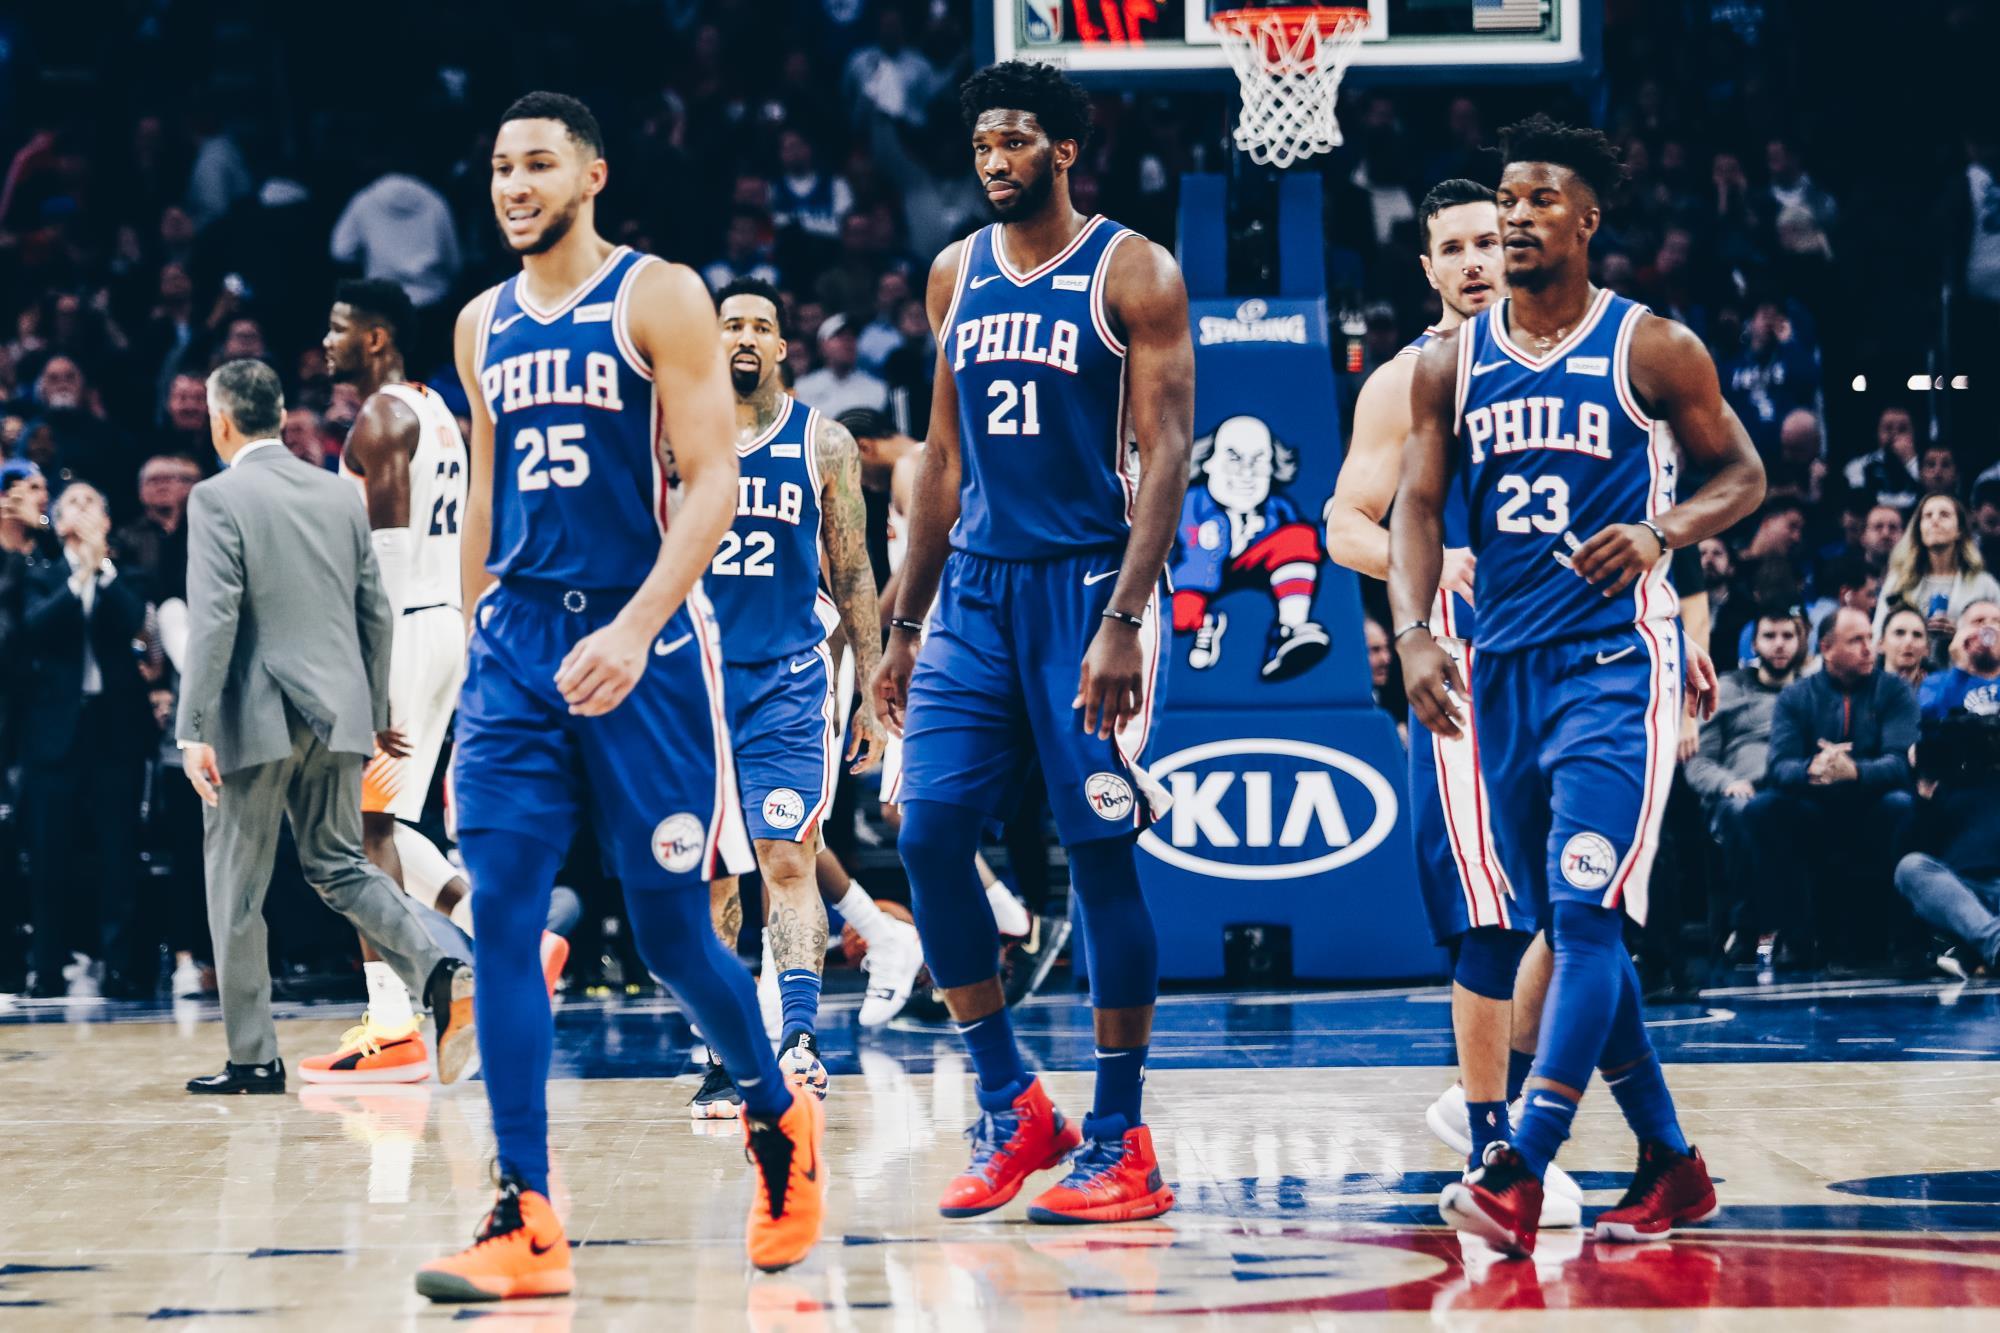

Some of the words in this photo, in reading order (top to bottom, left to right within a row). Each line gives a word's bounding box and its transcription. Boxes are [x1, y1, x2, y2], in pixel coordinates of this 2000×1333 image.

[954, 312, 1079, 374] PHILA
[481, 348, 624, 425] PHILA
[987, 379, 1040, 436] 21
[514, 423, 590, 492] 25
[1465, 396, 1612, 464] PHILA
[1496, 474, 1569, 533] 23
[711, 530, 775, 577] 22
[1168, 770, 1353, 848] KIA
